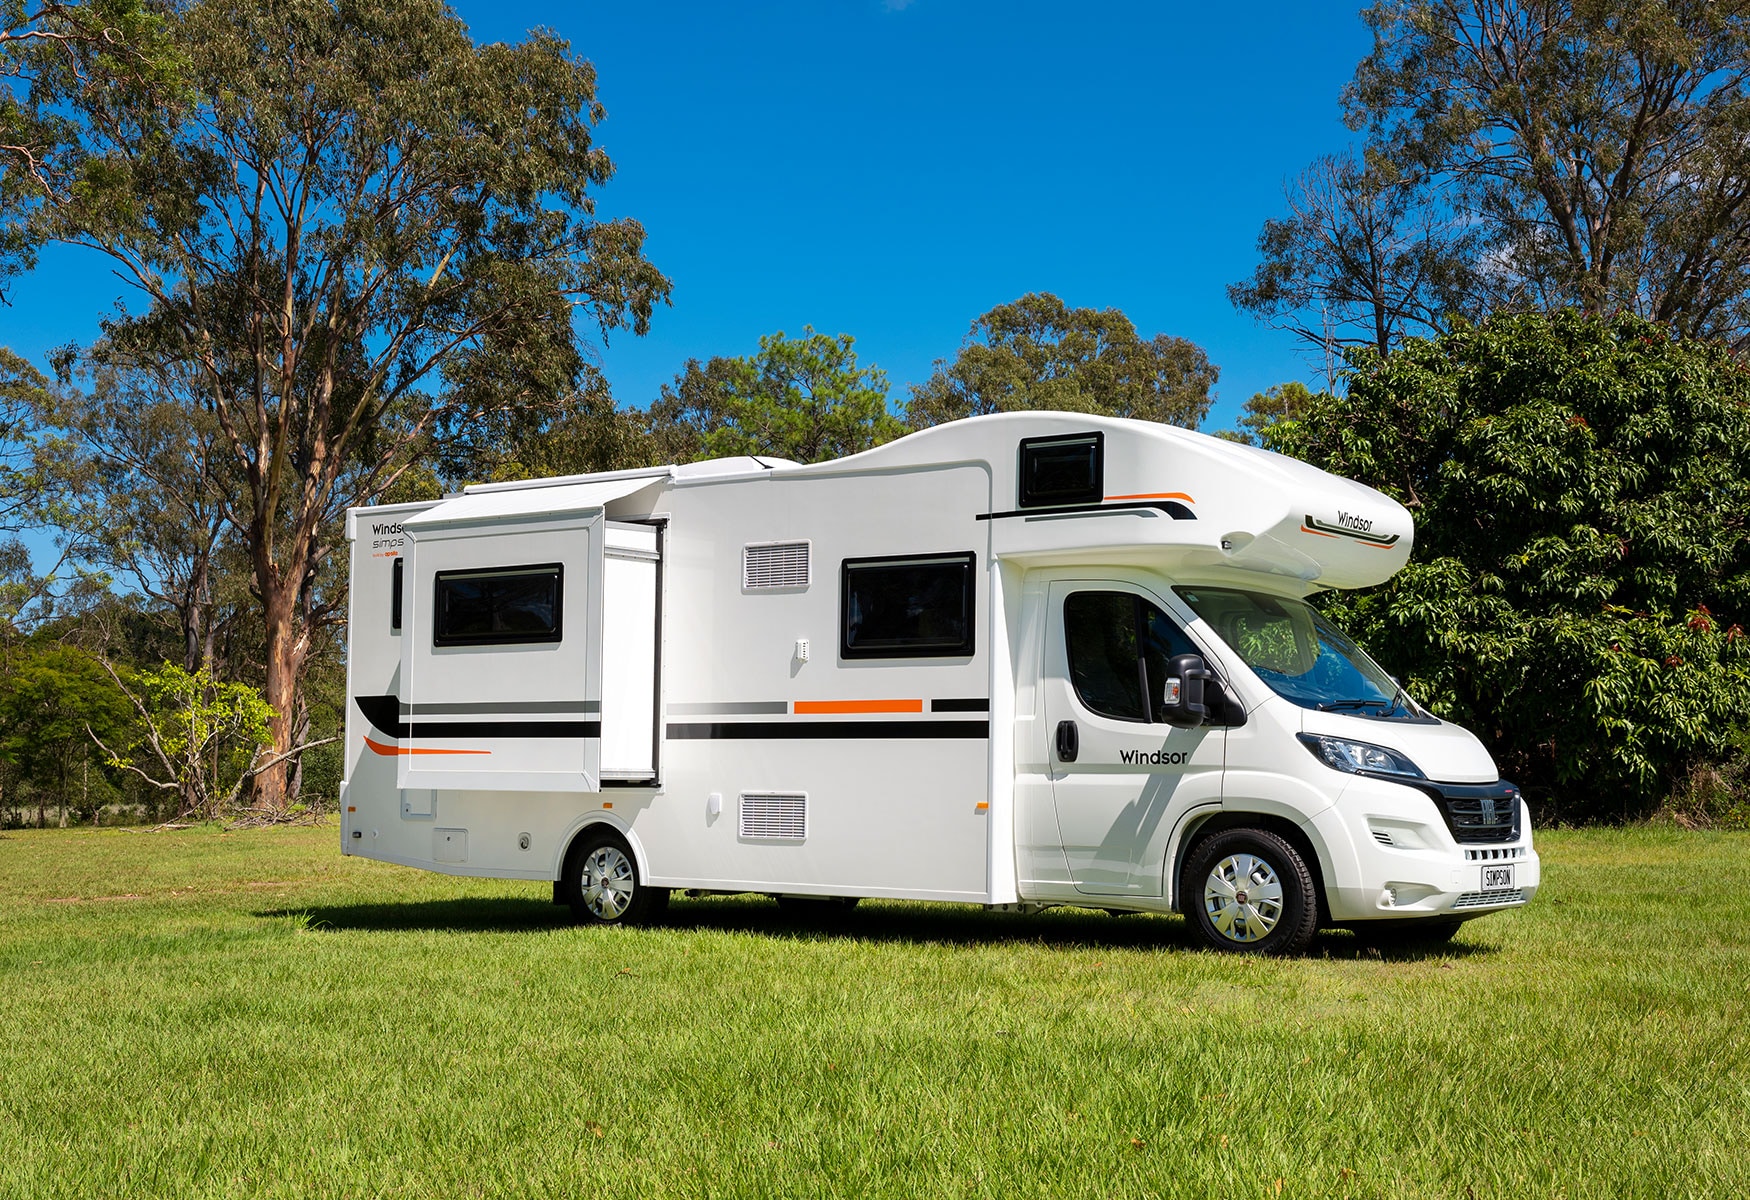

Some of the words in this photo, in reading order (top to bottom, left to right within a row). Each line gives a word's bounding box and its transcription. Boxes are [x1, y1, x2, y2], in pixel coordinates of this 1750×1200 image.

[372, 522, 404, 535] Winds
[1337, 510, 1373, 532] Windsor
[1119, 749, 1188, 765] Windsor
[1485, 869, 1511, 887] SIMPSON
